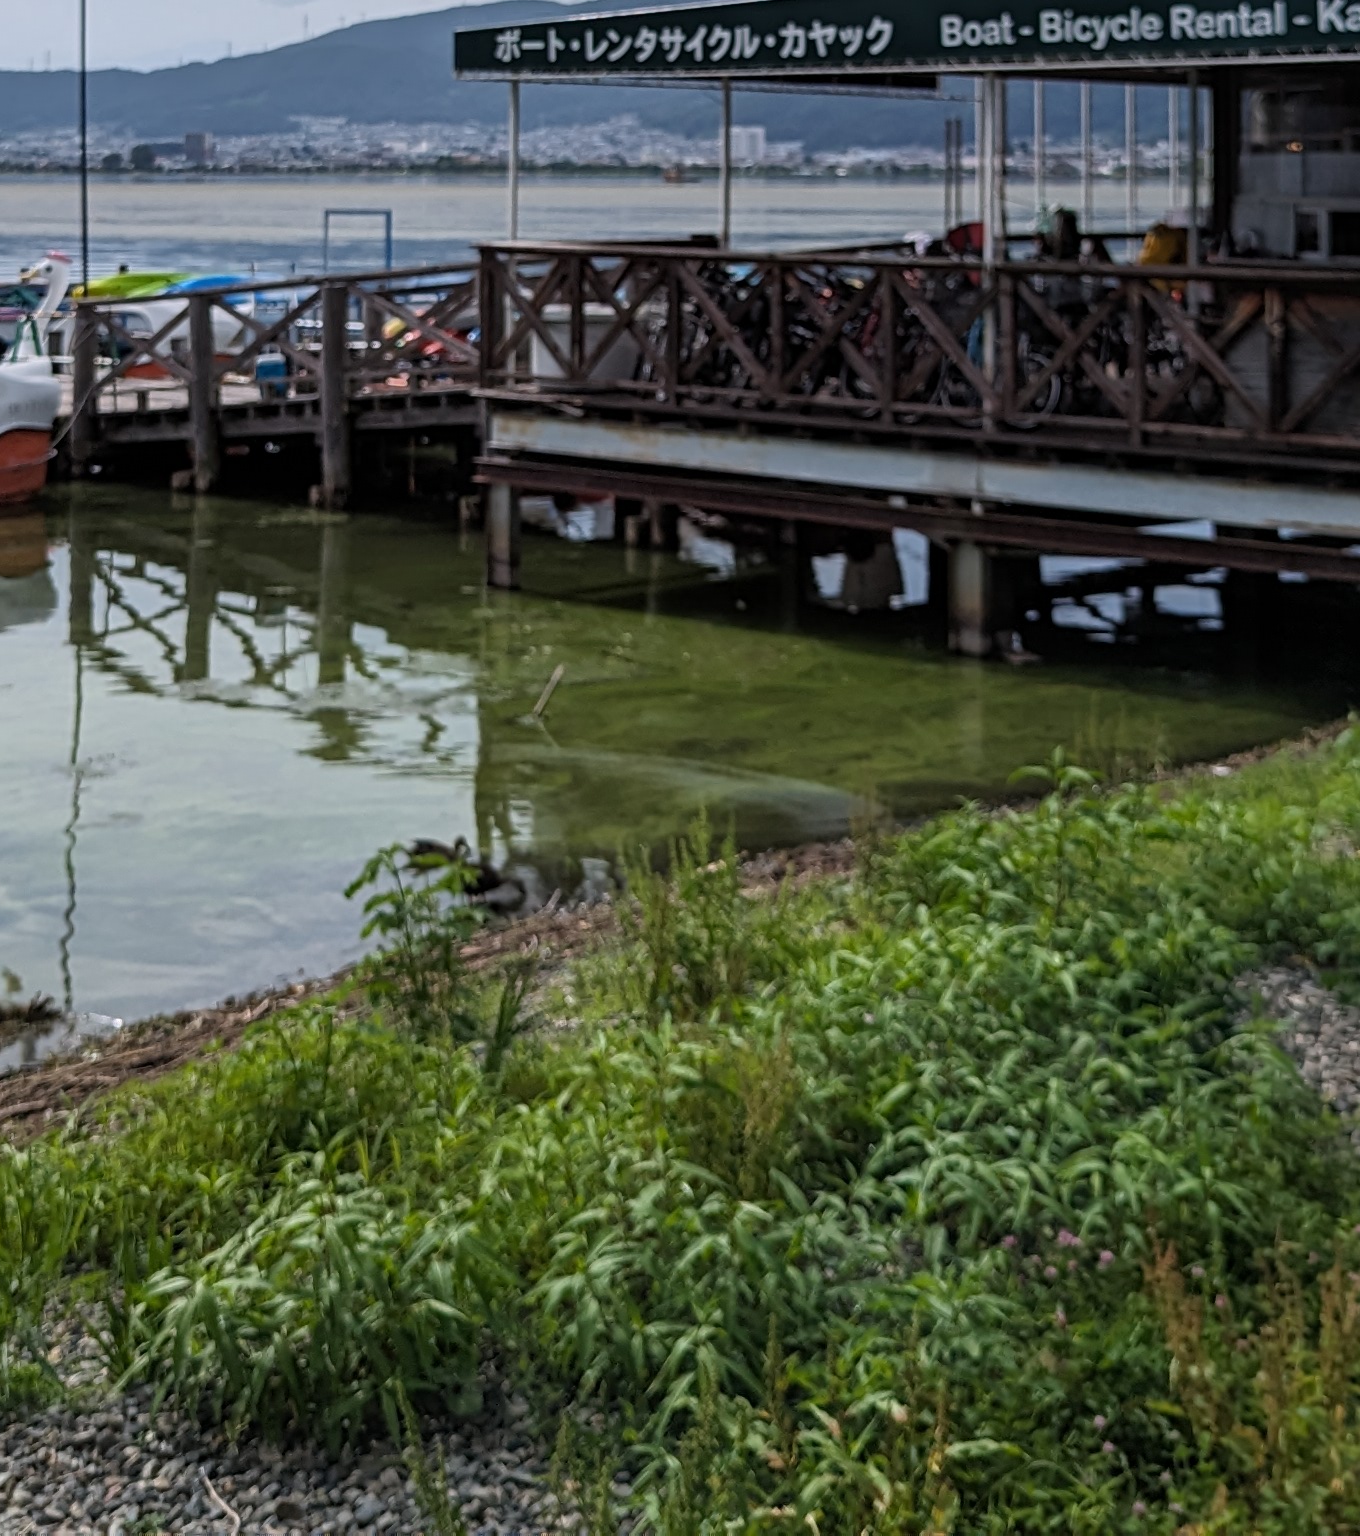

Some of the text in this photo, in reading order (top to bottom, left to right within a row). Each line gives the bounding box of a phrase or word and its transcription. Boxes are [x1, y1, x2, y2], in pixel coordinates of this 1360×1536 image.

[495, 16, 893, 63] ボート・レンタサイクル・カヤック
[940, 12, 1016, 47] Boat
[1040, 6, 1163, 51] Bicycle
[1169, 0, 1287, 40] Rental
